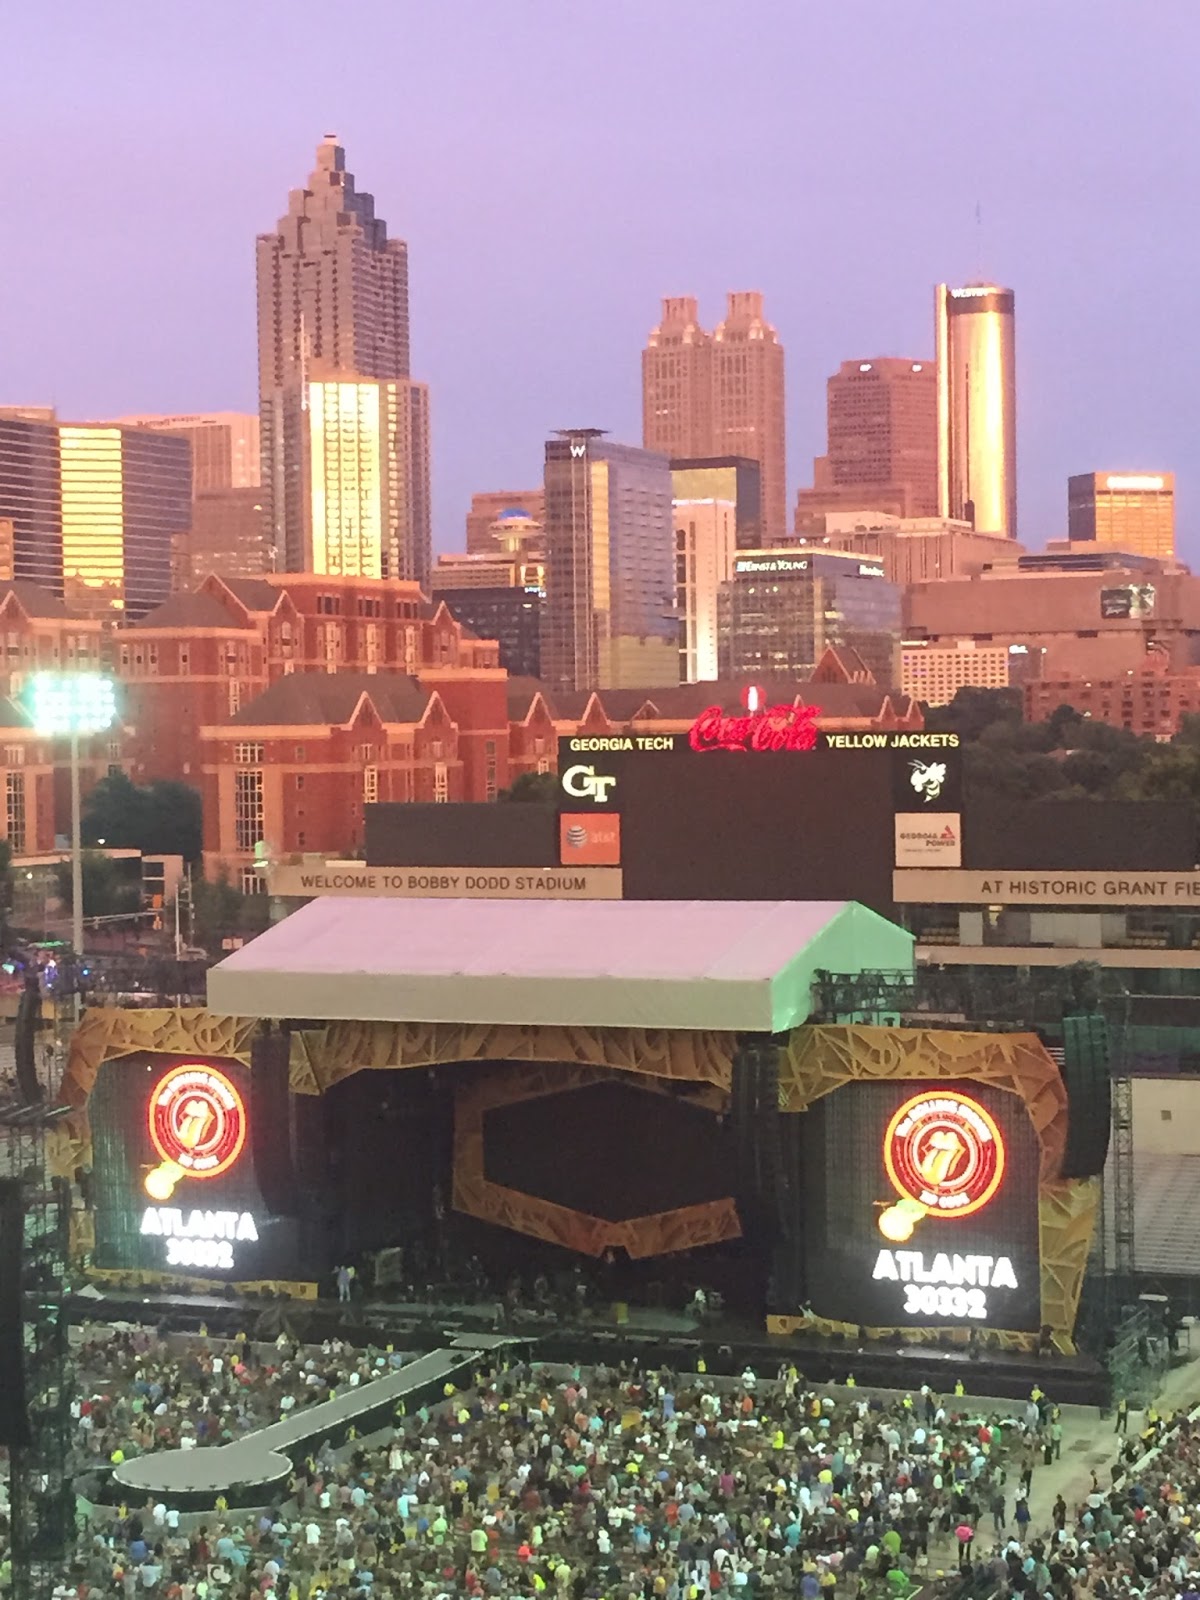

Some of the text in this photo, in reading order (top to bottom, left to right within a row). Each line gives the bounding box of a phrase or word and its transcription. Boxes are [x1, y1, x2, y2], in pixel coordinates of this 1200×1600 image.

[569, 445, 586, 458] W
[777, 560, 808, 571] YOUNG
[569, 737, 674, 751] GEORGIA TECH
[826, 733, 960, 748] YELLOW JACKETS
[562, 764, 616, 802] GT
[300, 874, 587, 891] WELCOME TO BOBBY DODD STADIUM
[981, 880, 1004, 894] AT
[1008, 880, 1097, 896] HISTORIC
[1103, 880, 1168, 896] GRANT
[140, 1206, 259, 1242] ATLANTA
[872, 1249, 1018, 1289] ATLANTA
[720, 1555, 734, 1572] A
